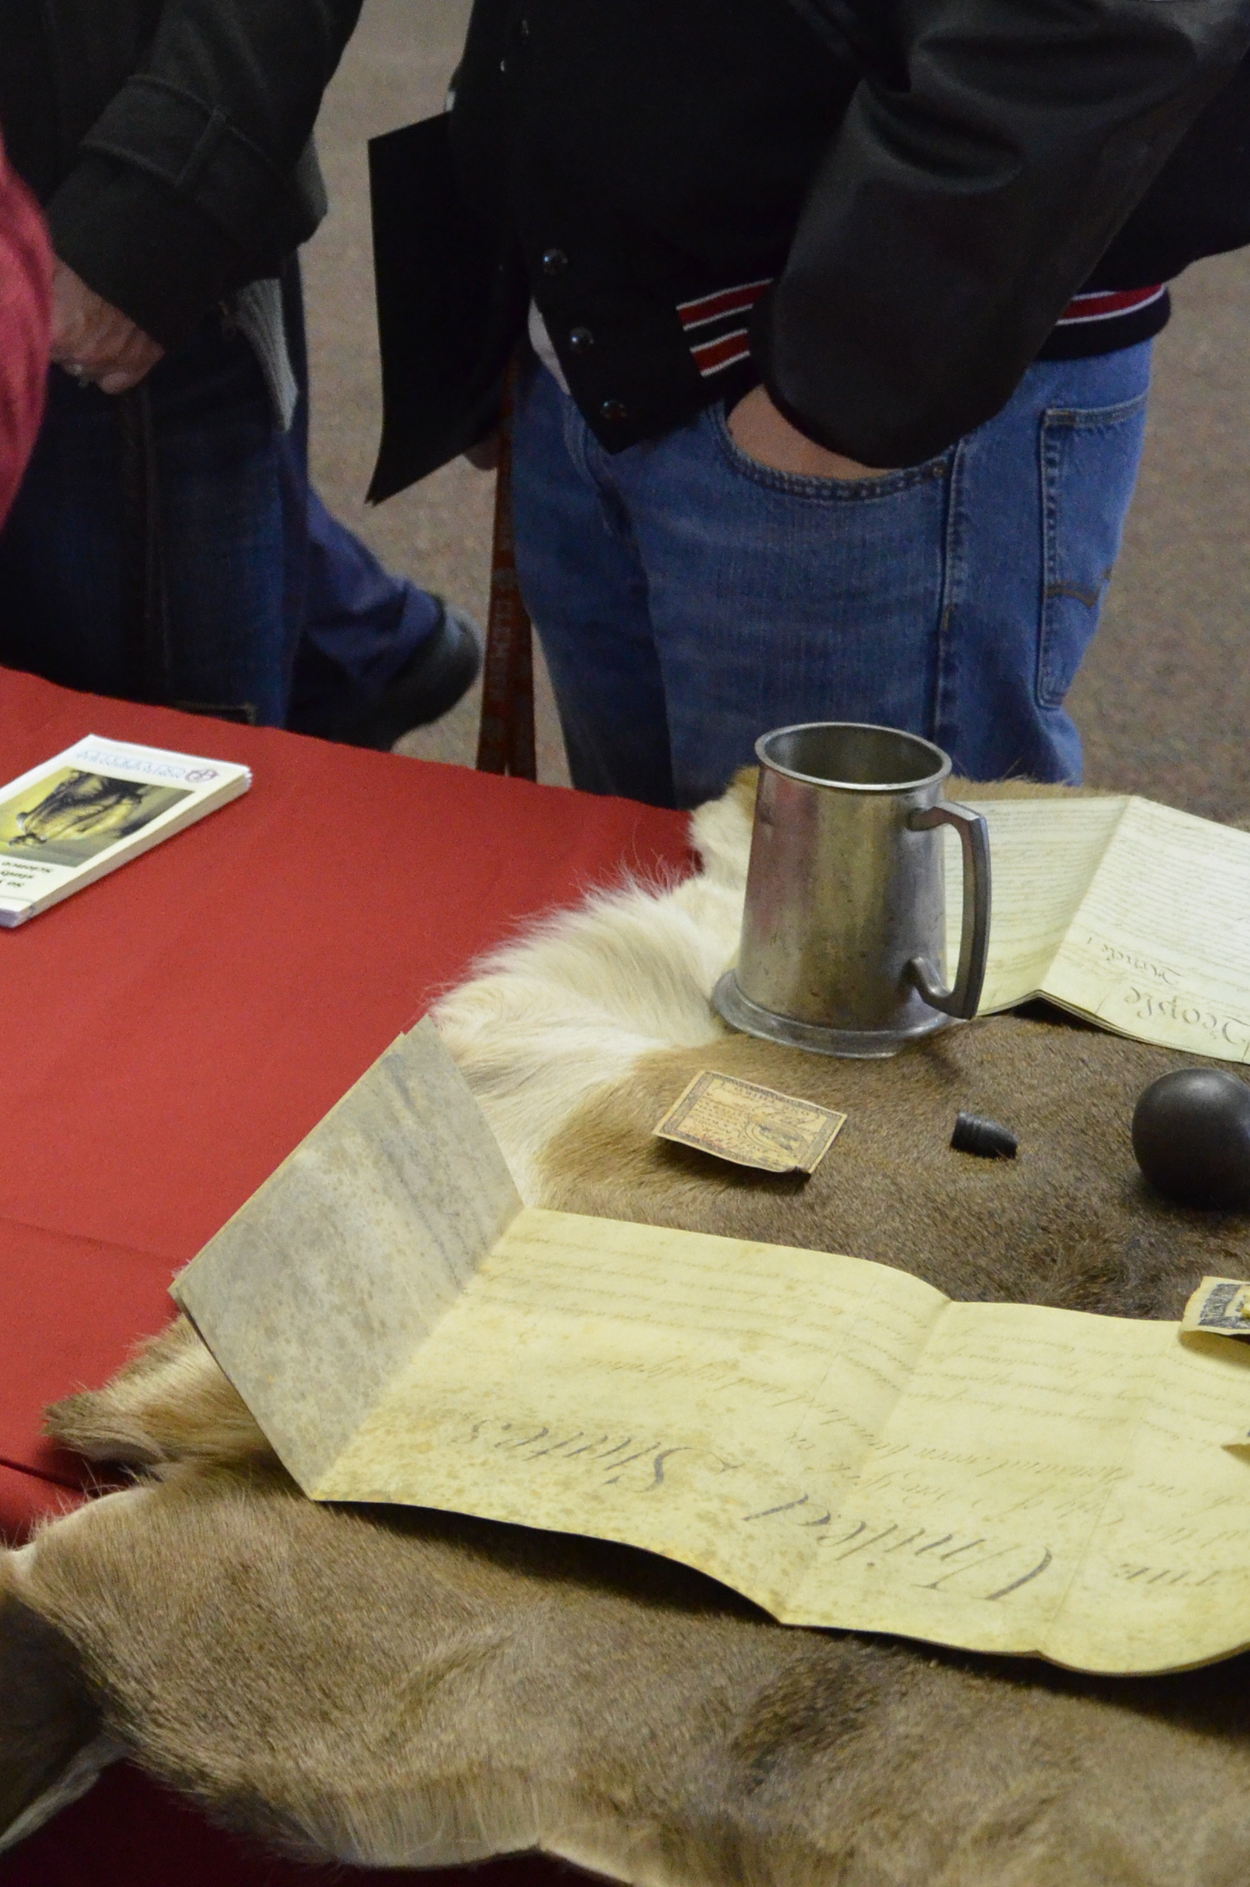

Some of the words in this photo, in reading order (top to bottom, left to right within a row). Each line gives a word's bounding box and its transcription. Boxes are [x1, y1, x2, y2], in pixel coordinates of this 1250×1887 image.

[1, 861, 53, 874] Science
[450, 1418, 744, 1494] States
[741, 1494, 1052, 1601] United
